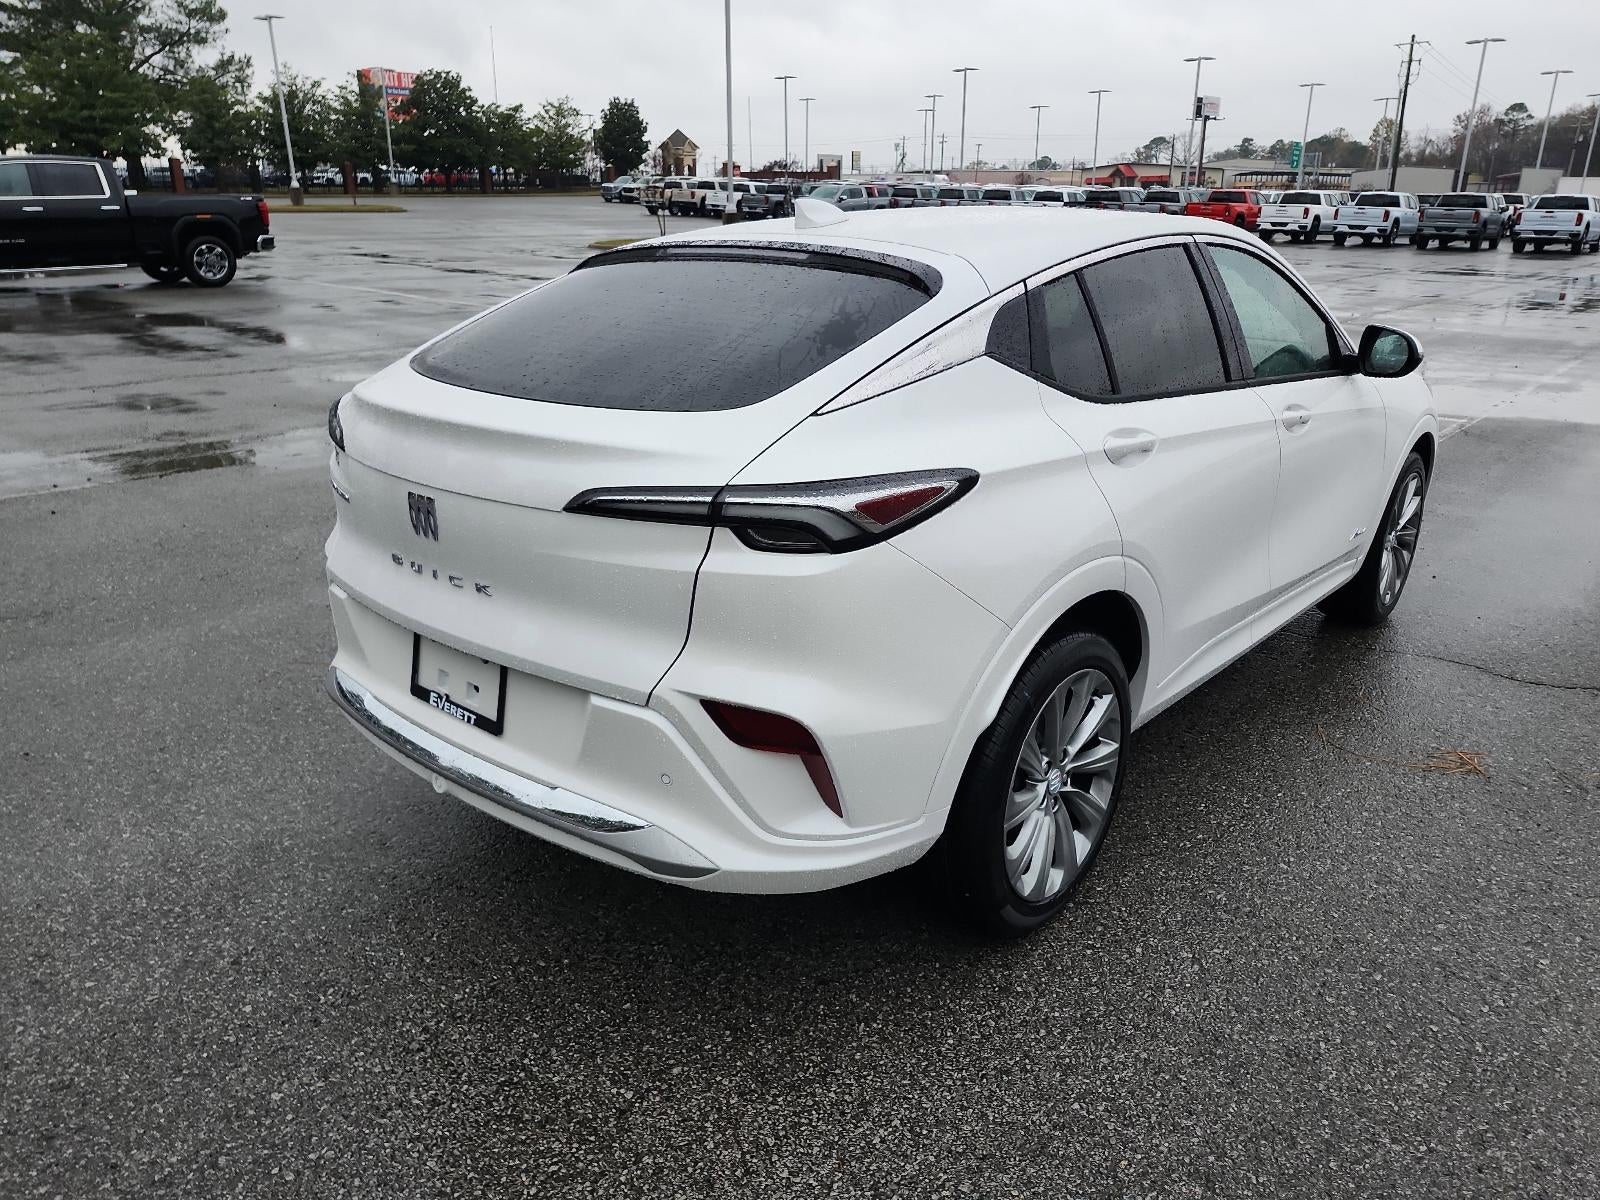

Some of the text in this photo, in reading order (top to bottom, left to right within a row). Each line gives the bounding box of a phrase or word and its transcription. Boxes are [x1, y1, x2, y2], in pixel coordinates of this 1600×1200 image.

[381, 69, 399, 87] XIT
[391, 553, 493, 597] BUICK
[429, 691, 477, 725] EVERETT
